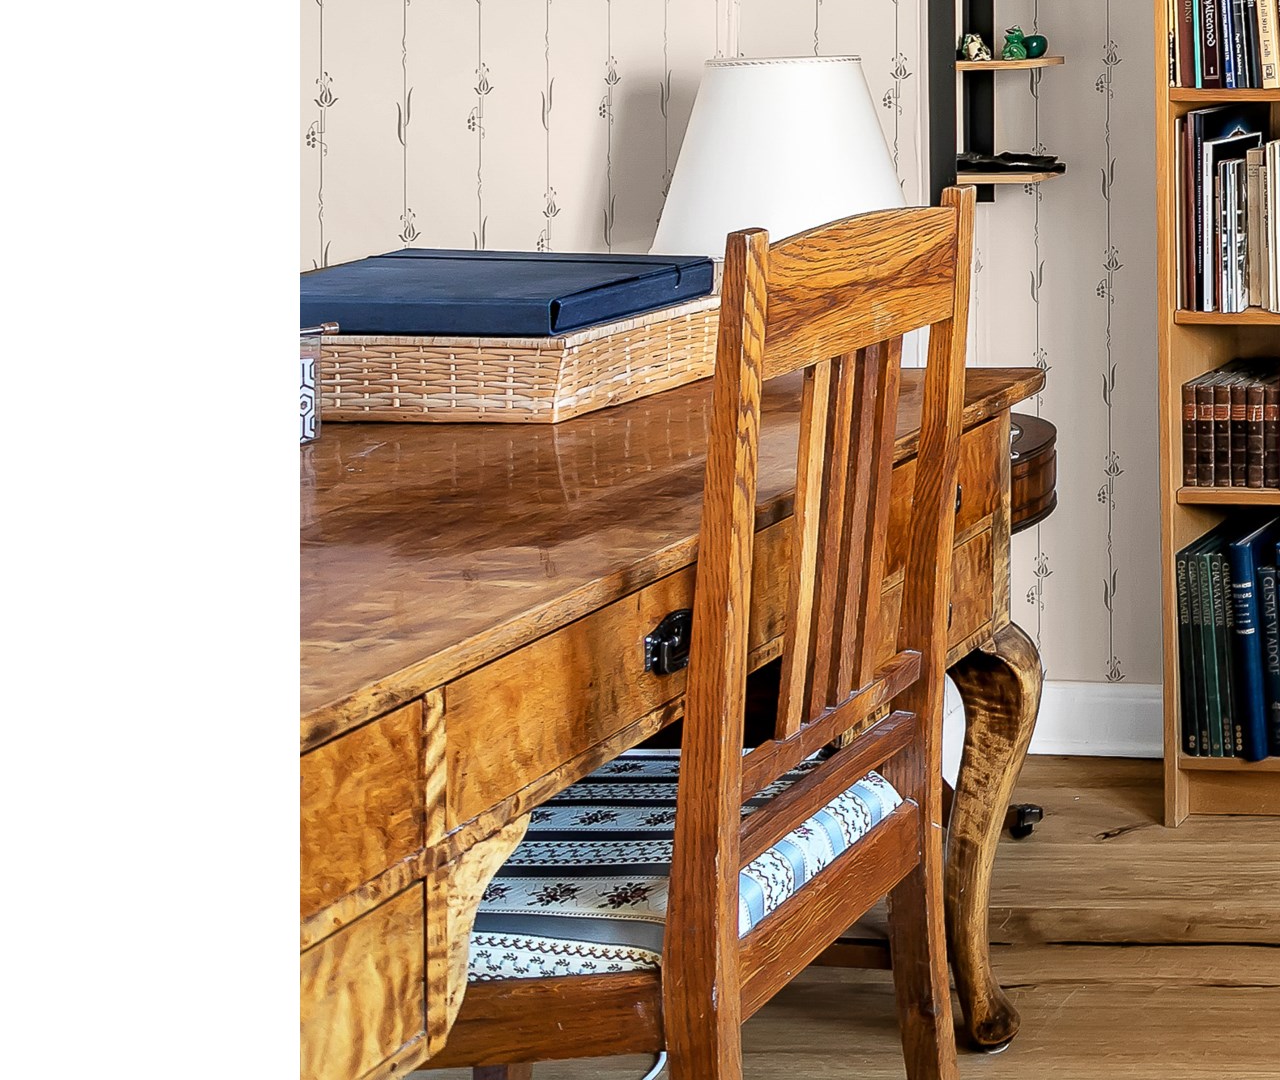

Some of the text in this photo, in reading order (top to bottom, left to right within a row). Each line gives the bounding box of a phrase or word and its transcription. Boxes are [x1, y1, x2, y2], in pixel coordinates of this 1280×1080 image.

[1177, 560, 1189, 625] CHALMA MATER
[1199, 561, 1211, 627] CHALMA MATER
[1211, 561, 1223, 627] CHALMA MATER
[1222, 562, 1234, 628] CHALMA MATER
[1262, 576, 1279, 676] GUSTAF VI ADOLF
